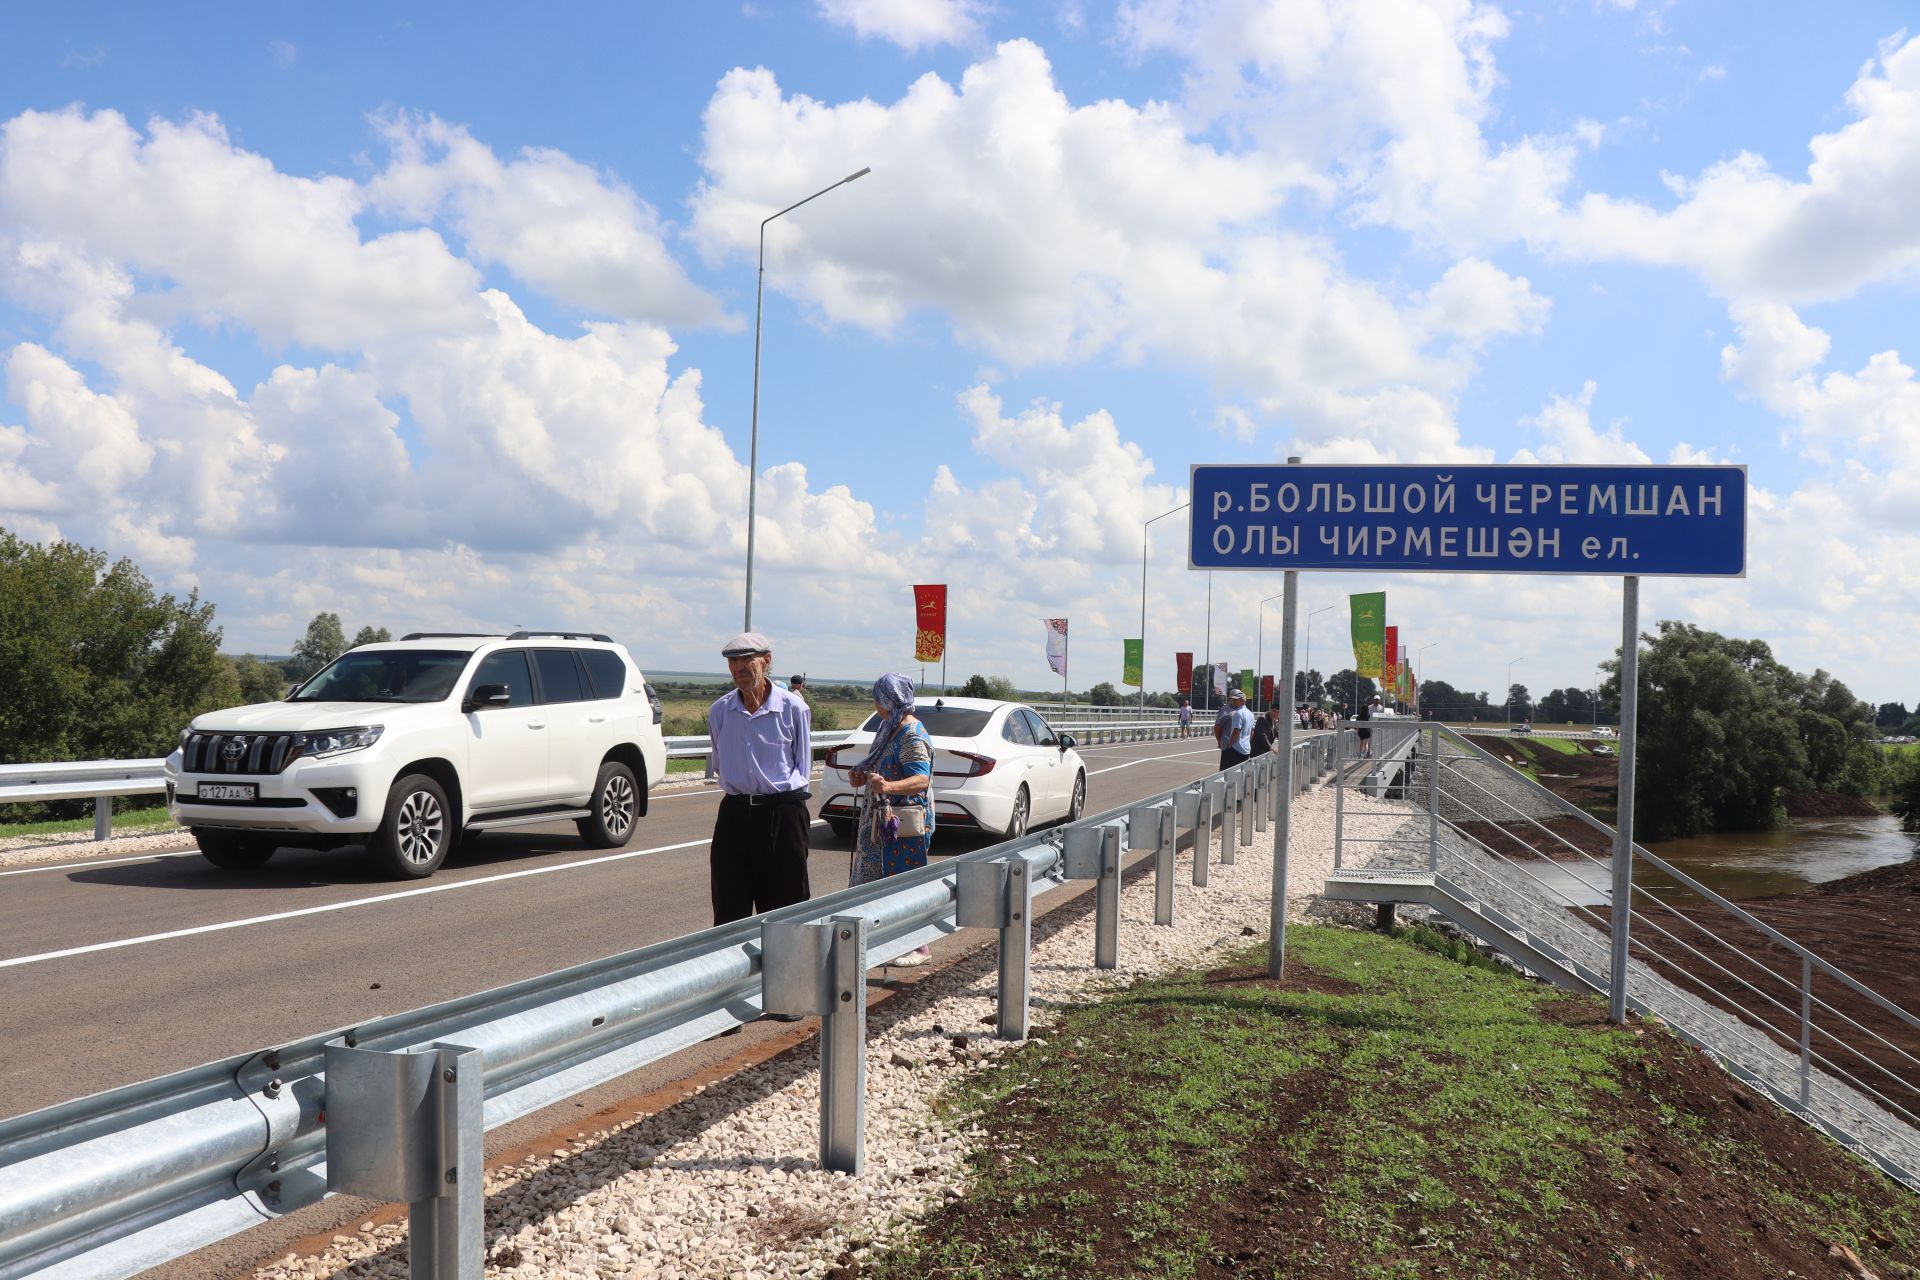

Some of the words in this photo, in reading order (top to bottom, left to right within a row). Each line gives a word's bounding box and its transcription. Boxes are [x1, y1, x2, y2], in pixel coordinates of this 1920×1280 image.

[1213, 474, 1455, 520] р.БОЛЬШОЙ
[1476, 483, 1722, 516] ЧЕРЕМШАН
[1213, 524, 1299, 555] ОЛЫ
[1319, 525, 1560, 559] ЧИРМЕШӘН
[1581, 535, 1640, 559] ел.
